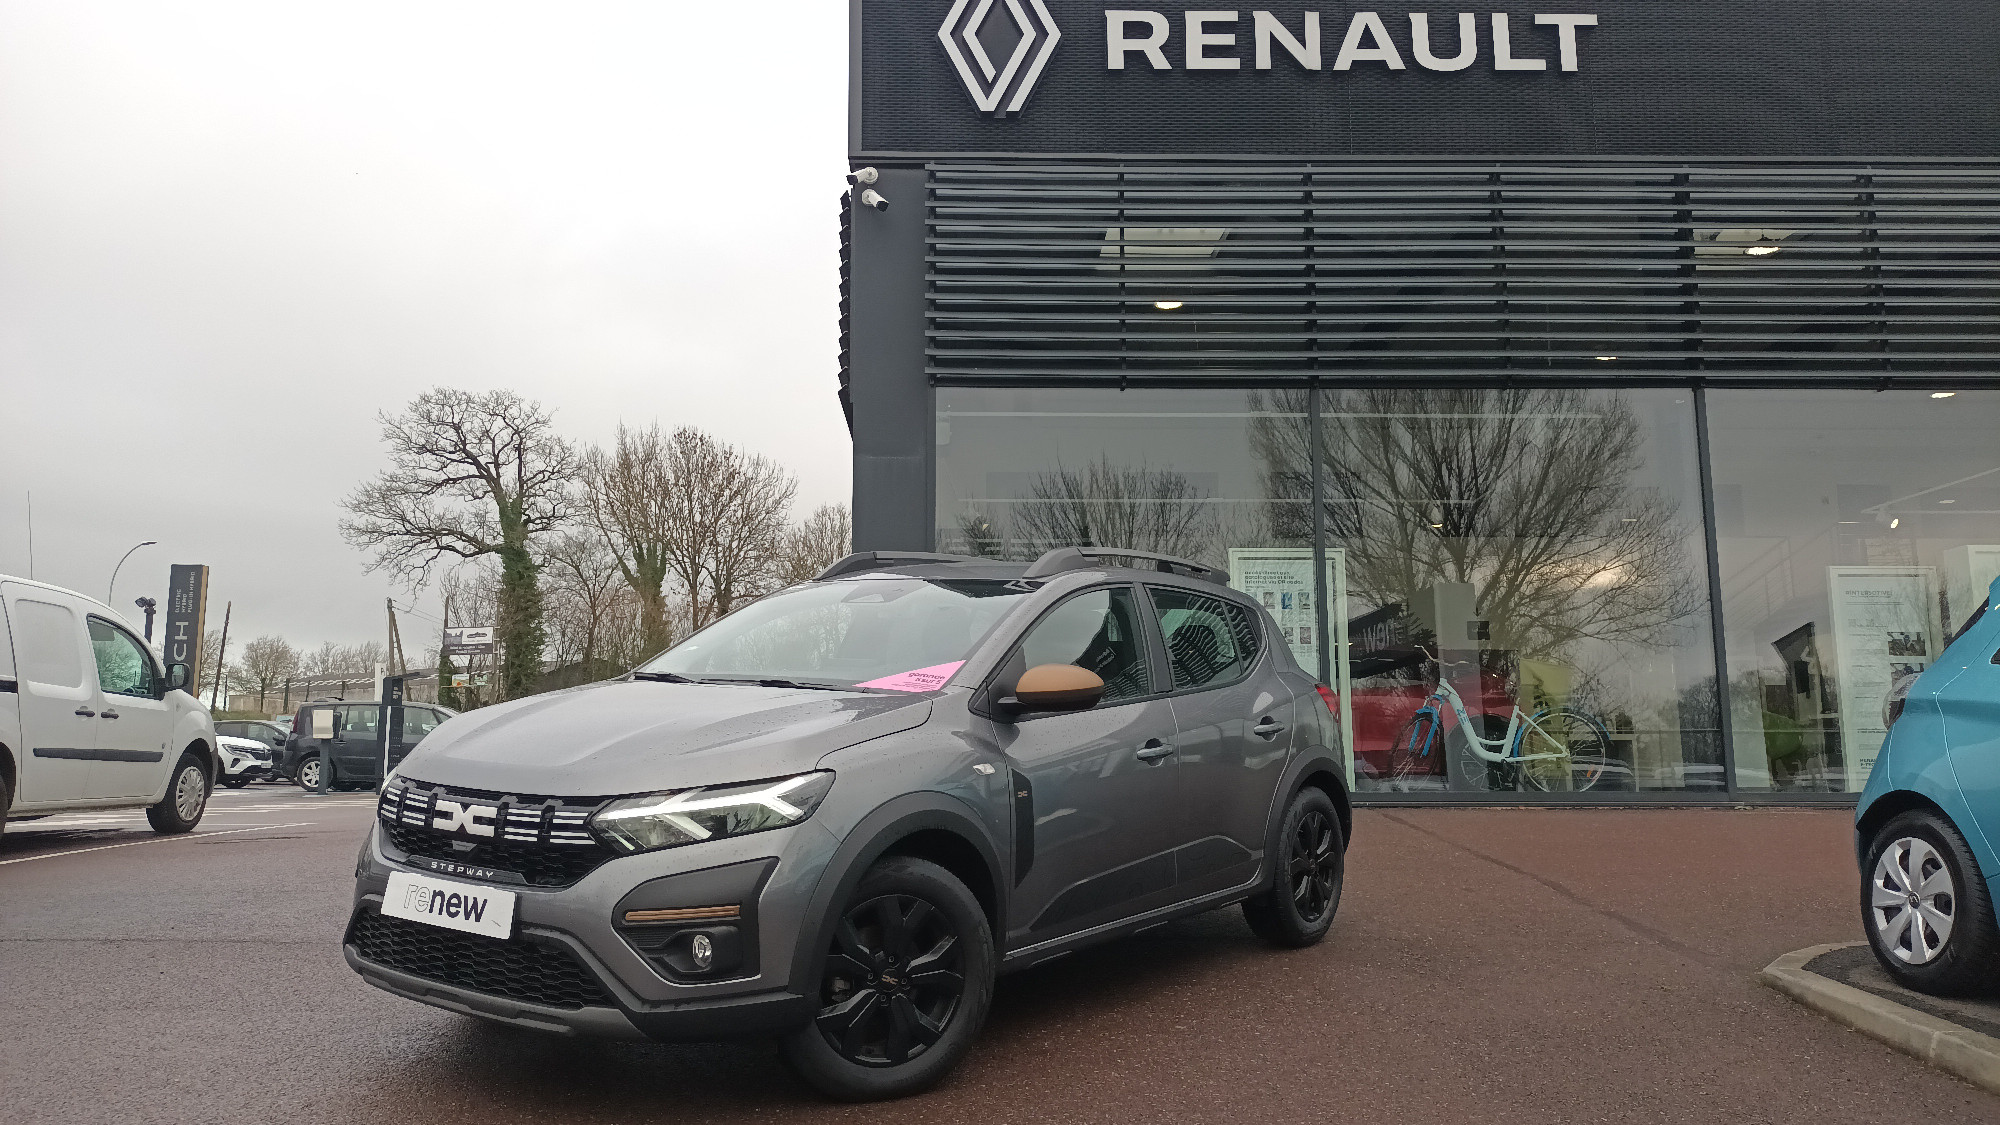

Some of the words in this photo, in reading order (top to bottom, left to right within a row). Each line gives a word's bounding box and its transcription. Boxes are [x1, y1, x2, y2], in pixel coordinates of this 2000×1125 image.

[1104, 10, 1598, 71] RENAULT
[430, 861, 494, 878] STEPWAY
[404, 884, 487, 922] renew
